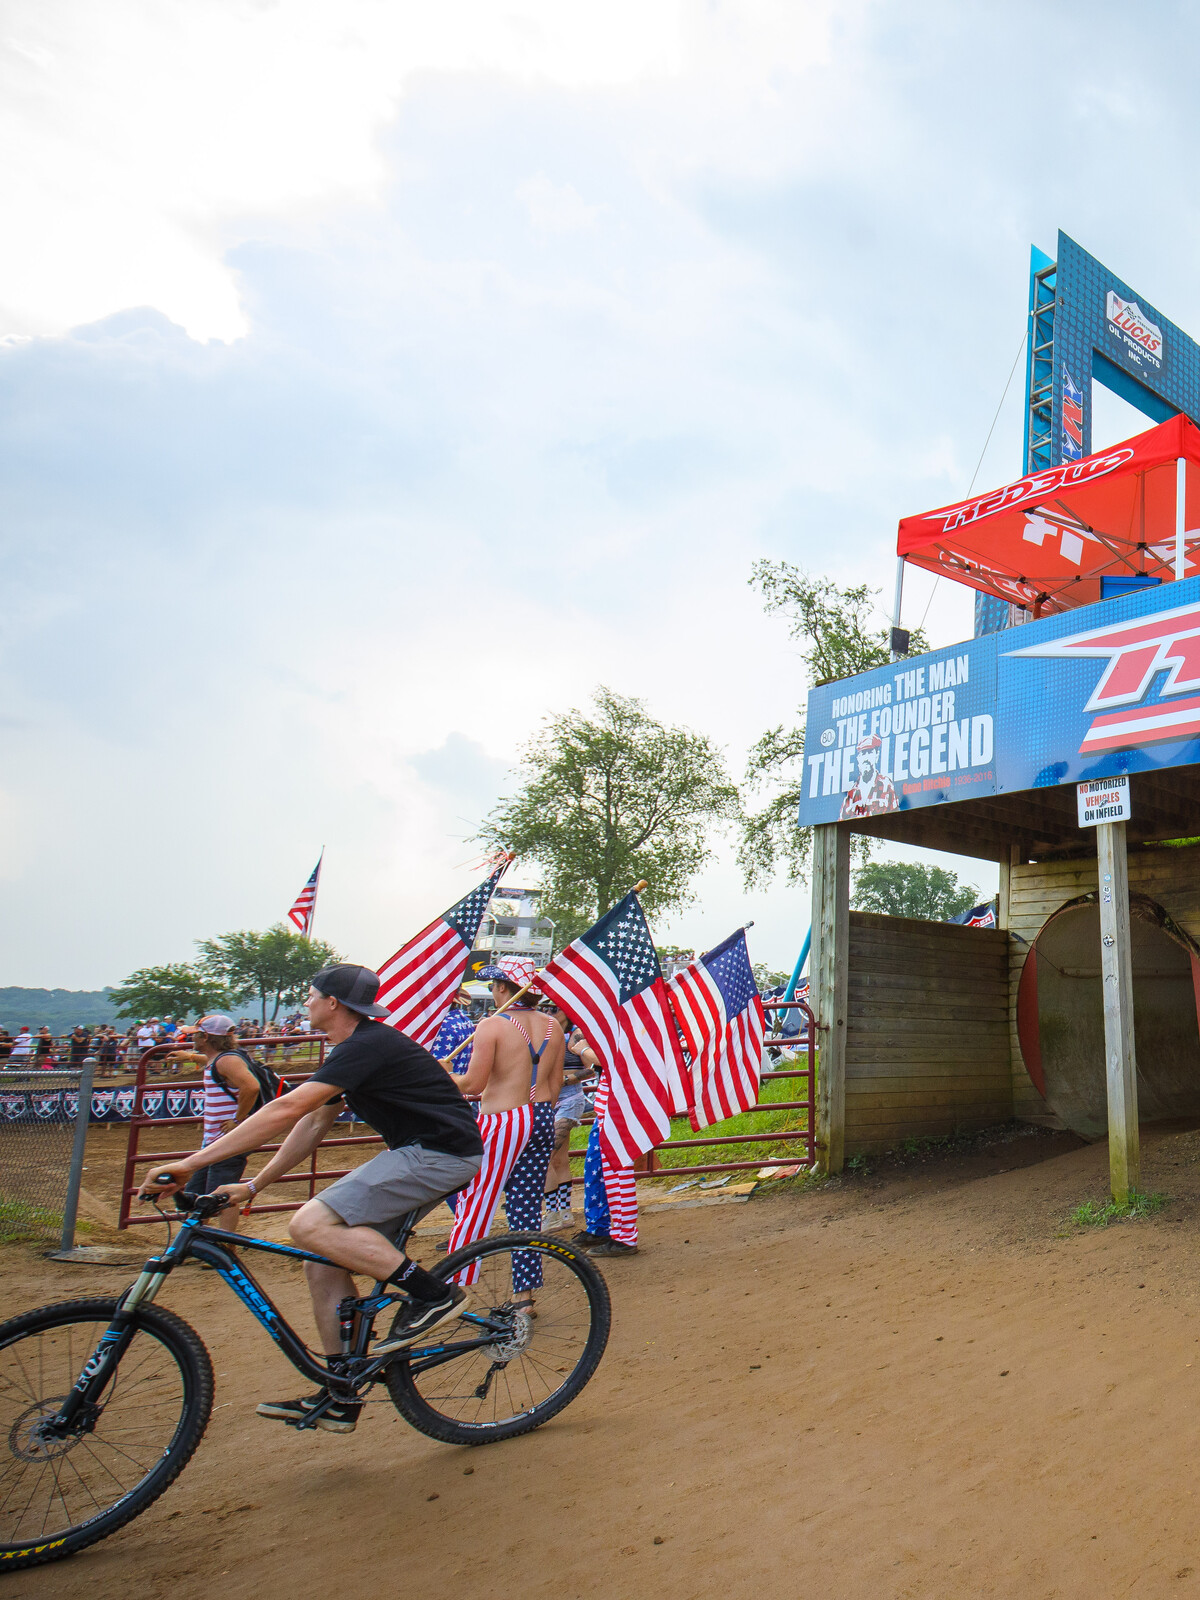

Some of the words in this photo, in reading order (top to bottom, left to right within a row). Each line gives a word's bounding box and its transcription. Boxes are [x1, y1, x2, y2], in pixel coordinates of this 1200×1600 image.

[1108, 324, 1122, 340] OIL
[1123, 335, 1161, 369] PRODUCTS
[1113, 312, 1161, 351] LUCAS
[832, 684, 892, 719] HONORING
[894, 667, 926, 699] THE
[928, 654, 969, 691] MAN
[836, 713, 868, 749] THE
[870, 690, 955, 738] FOUNDER
[807, 745, 857, 799] THE
[880, 713, 994, 782] LEGEND
[903, 781, 922, 795] Gene
[954, 770, 992, 786] 1936-2016
[1079, 784, 1089, 795] NO
[1089, 777, 1127, 793] MOTORIZED
[1084, 810, 1095, 821] ON
[1096, 804, 1123, 820] INFIELD
[529, 1240, 576, 1260] MAXXIS
[229, 1263, 278, 1322] TREK
[0, 1537, 67, 1560] MAXX
